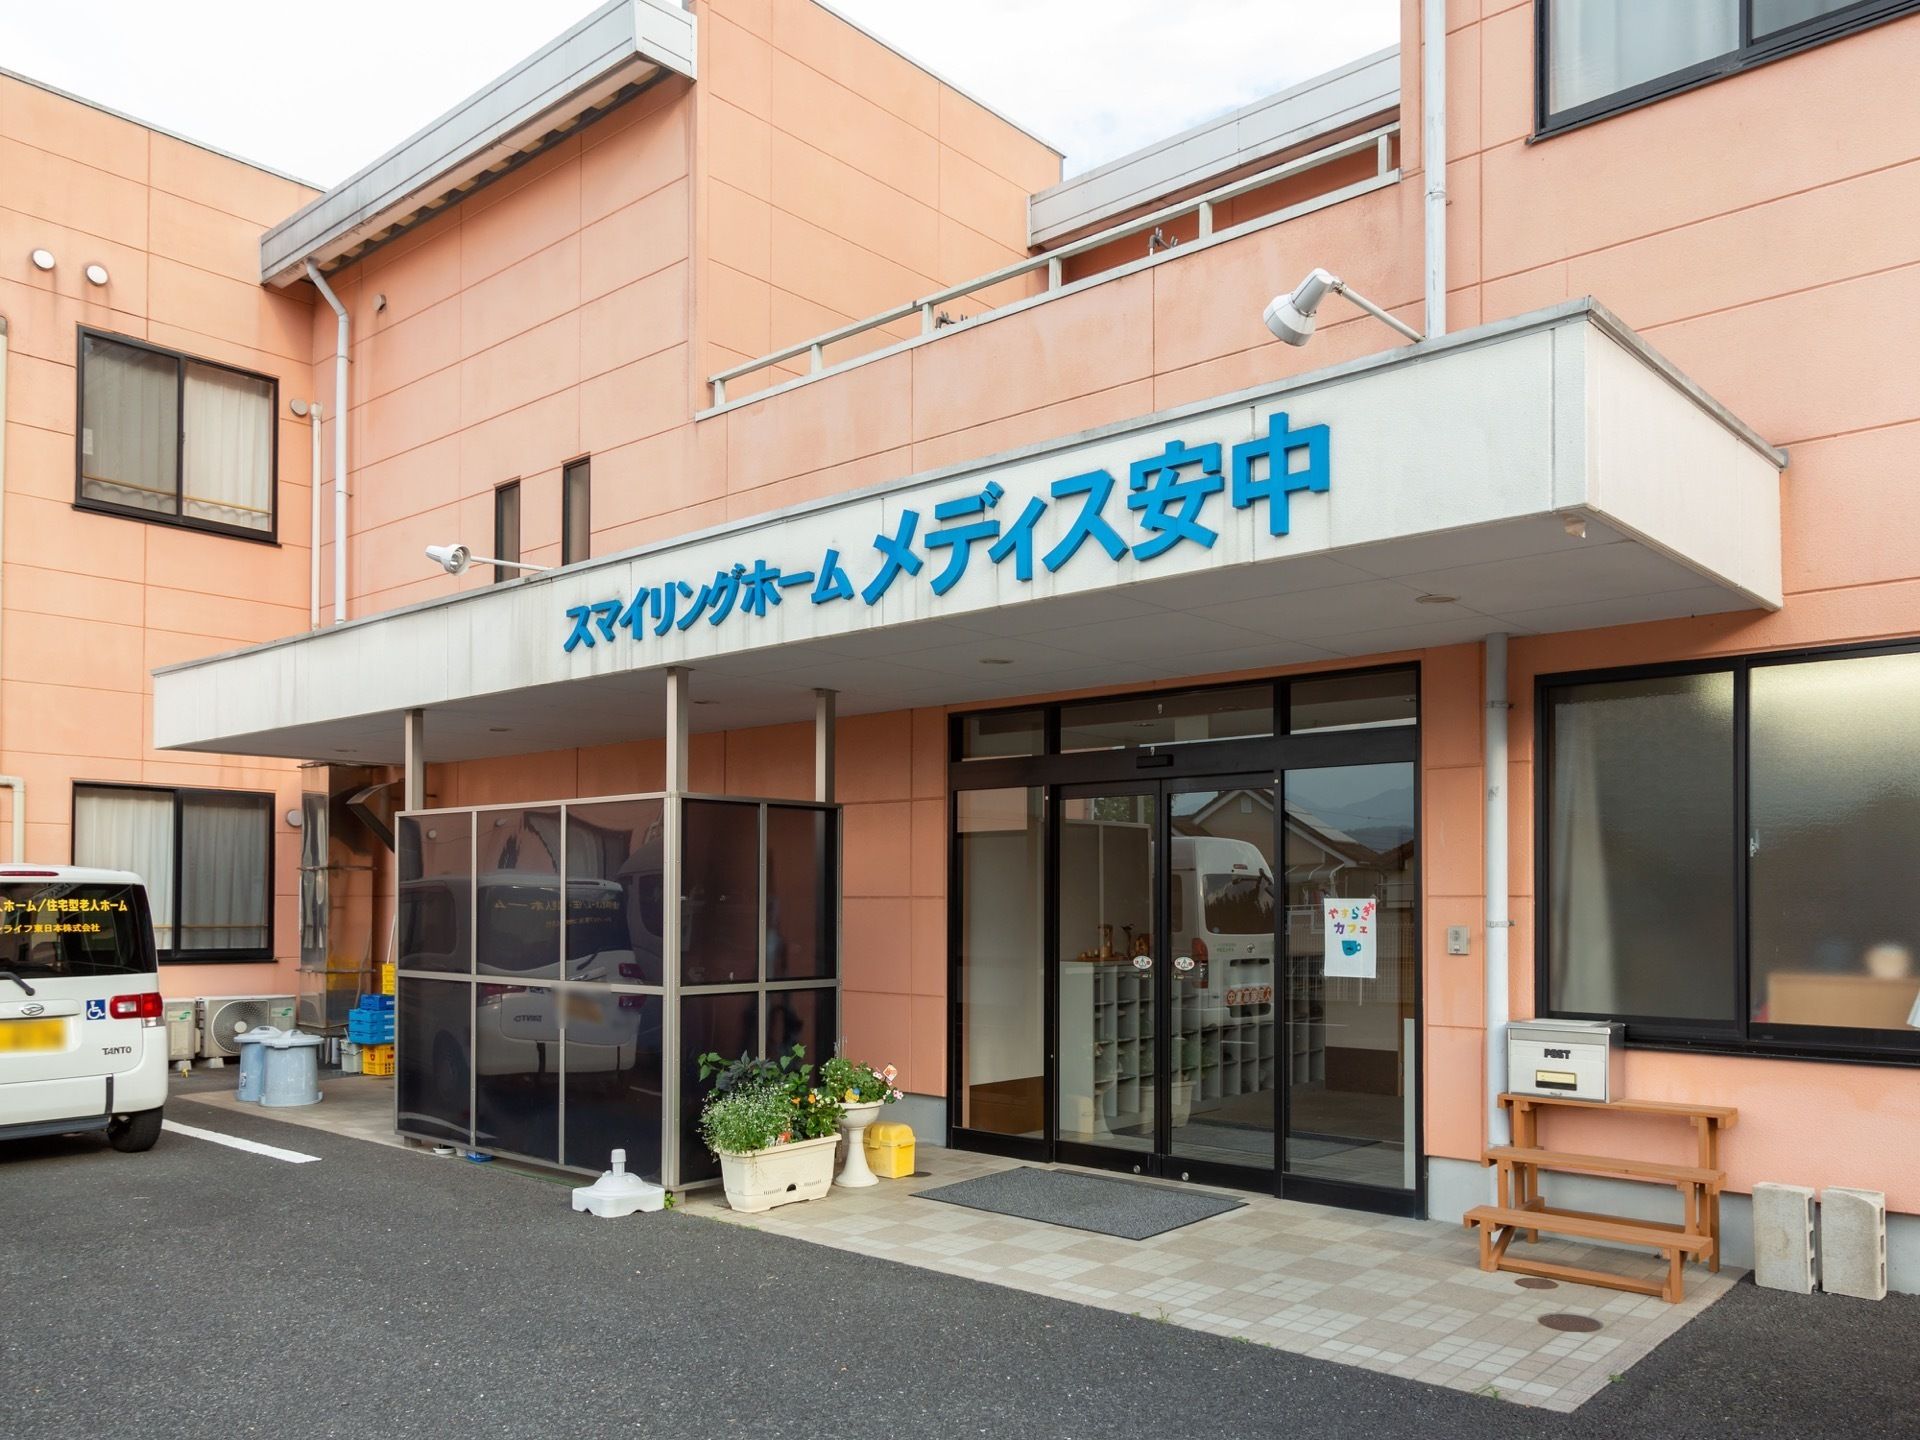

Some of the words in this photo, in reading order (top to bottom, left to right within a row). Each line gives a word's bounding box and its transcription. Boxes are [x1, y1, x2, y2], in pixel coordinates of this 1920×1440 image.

[563, 548, 855, 653] スマイリングホーム
[860, 411, 1330, 607] メディス安中
[0, 899, 128, 913] ホーム/住宅型老人ホーム
[1328, 900, 1375, 921] やすらぎ
[1334, 922, 1368, 935] カフェ
[101, 1046, 132, 1055] TANTO
[1543, 1048, 1571, 1060] POST
